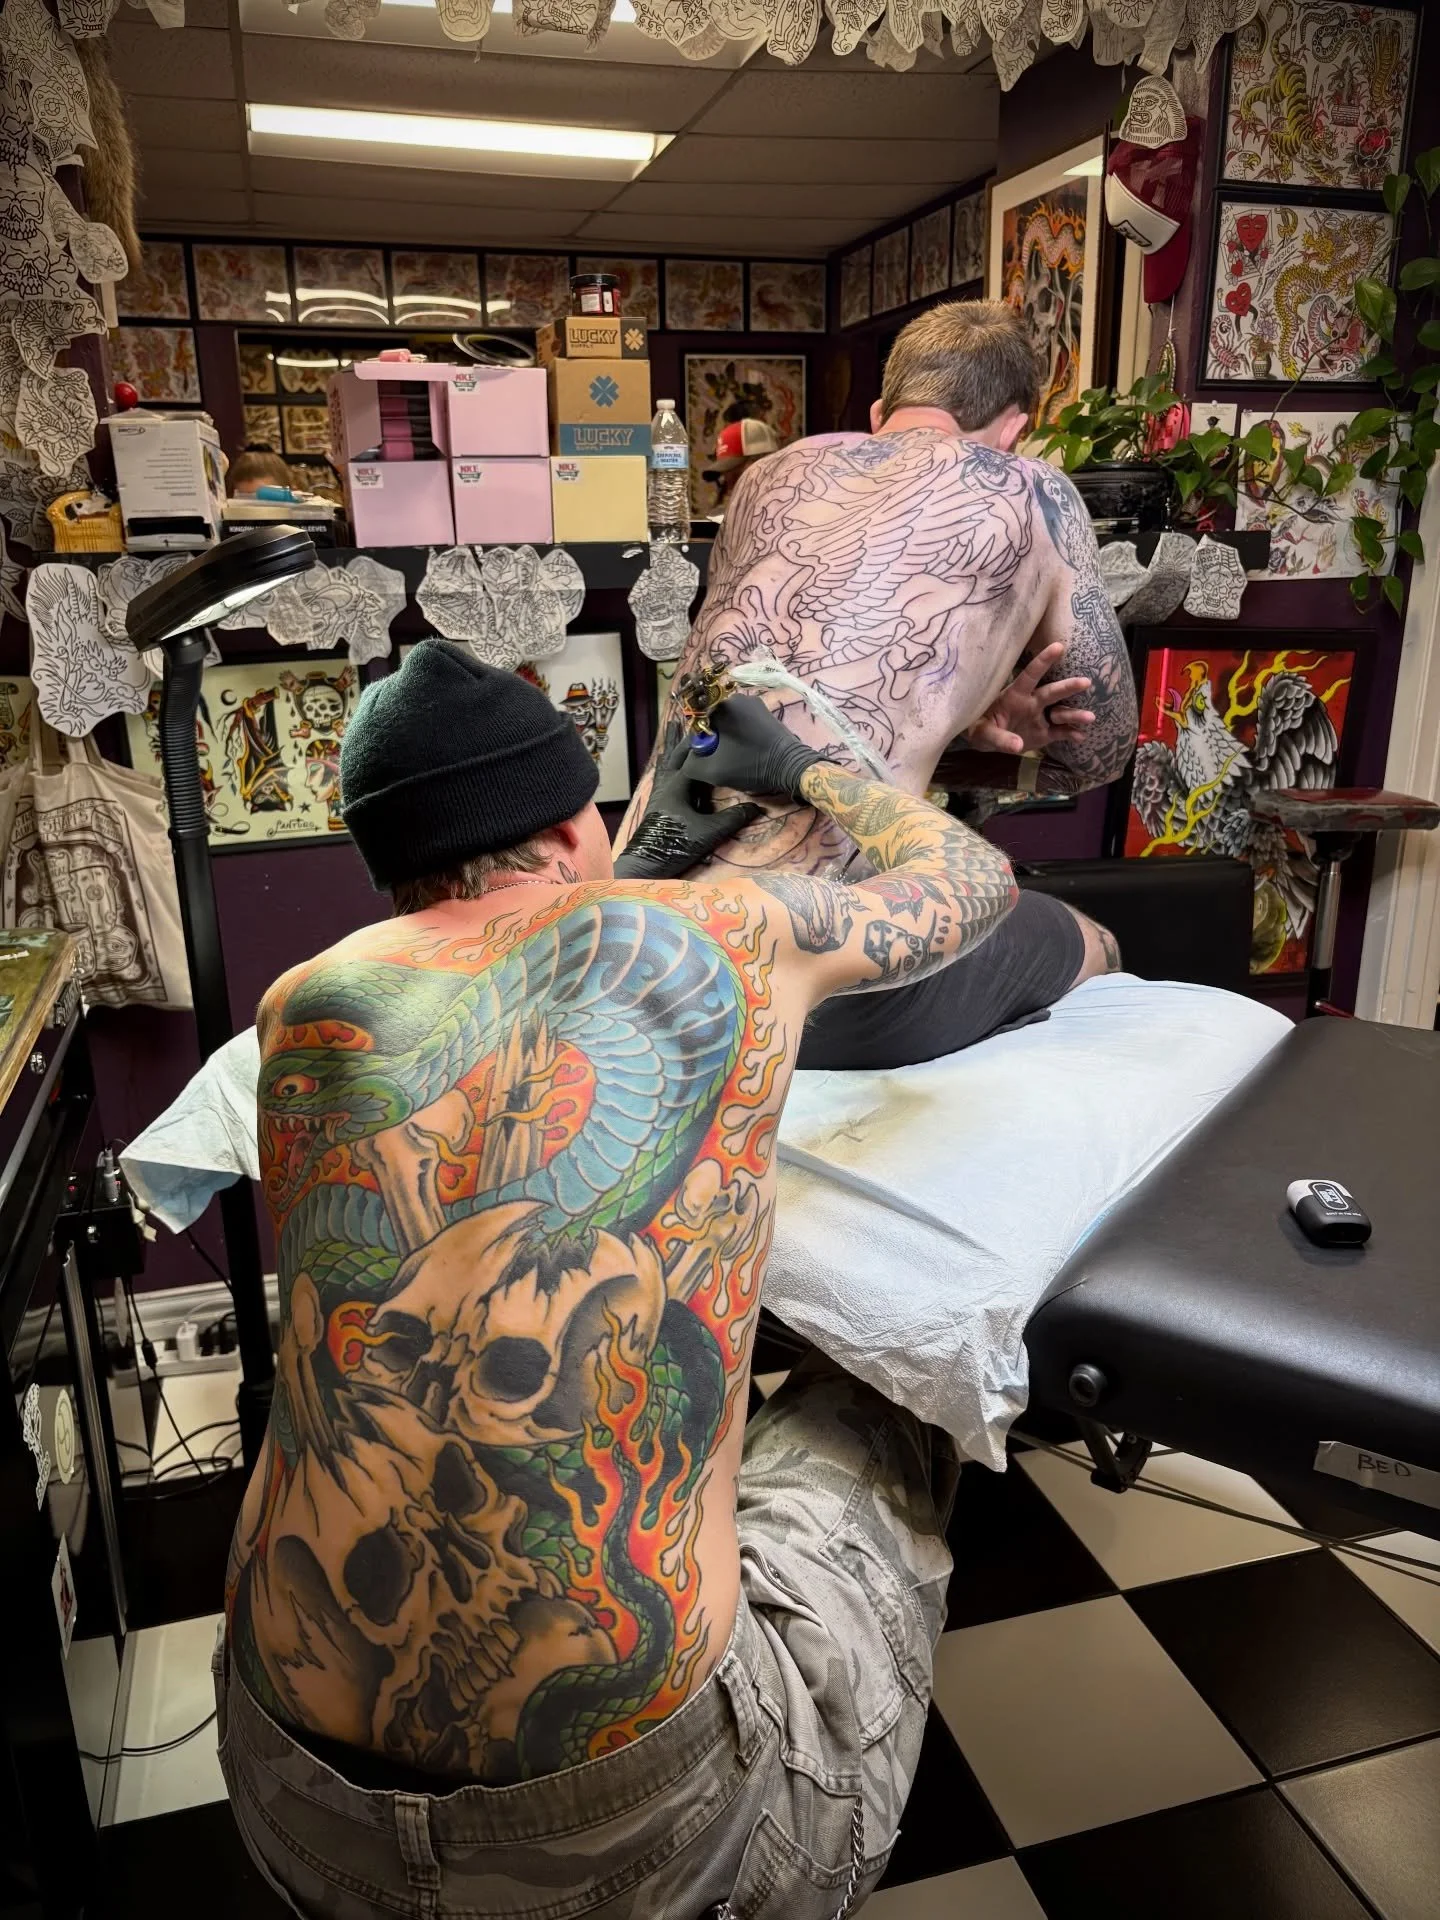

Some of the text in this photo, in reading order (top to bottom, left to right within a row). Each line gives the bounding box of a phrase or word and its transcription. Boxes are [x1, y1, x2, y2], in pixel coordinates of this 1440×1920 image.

[568, 328, 618, 344] LUCKY
[573, 428, 634, 446] LUCKY
[1357, 1453, 1411, 1477] BED
